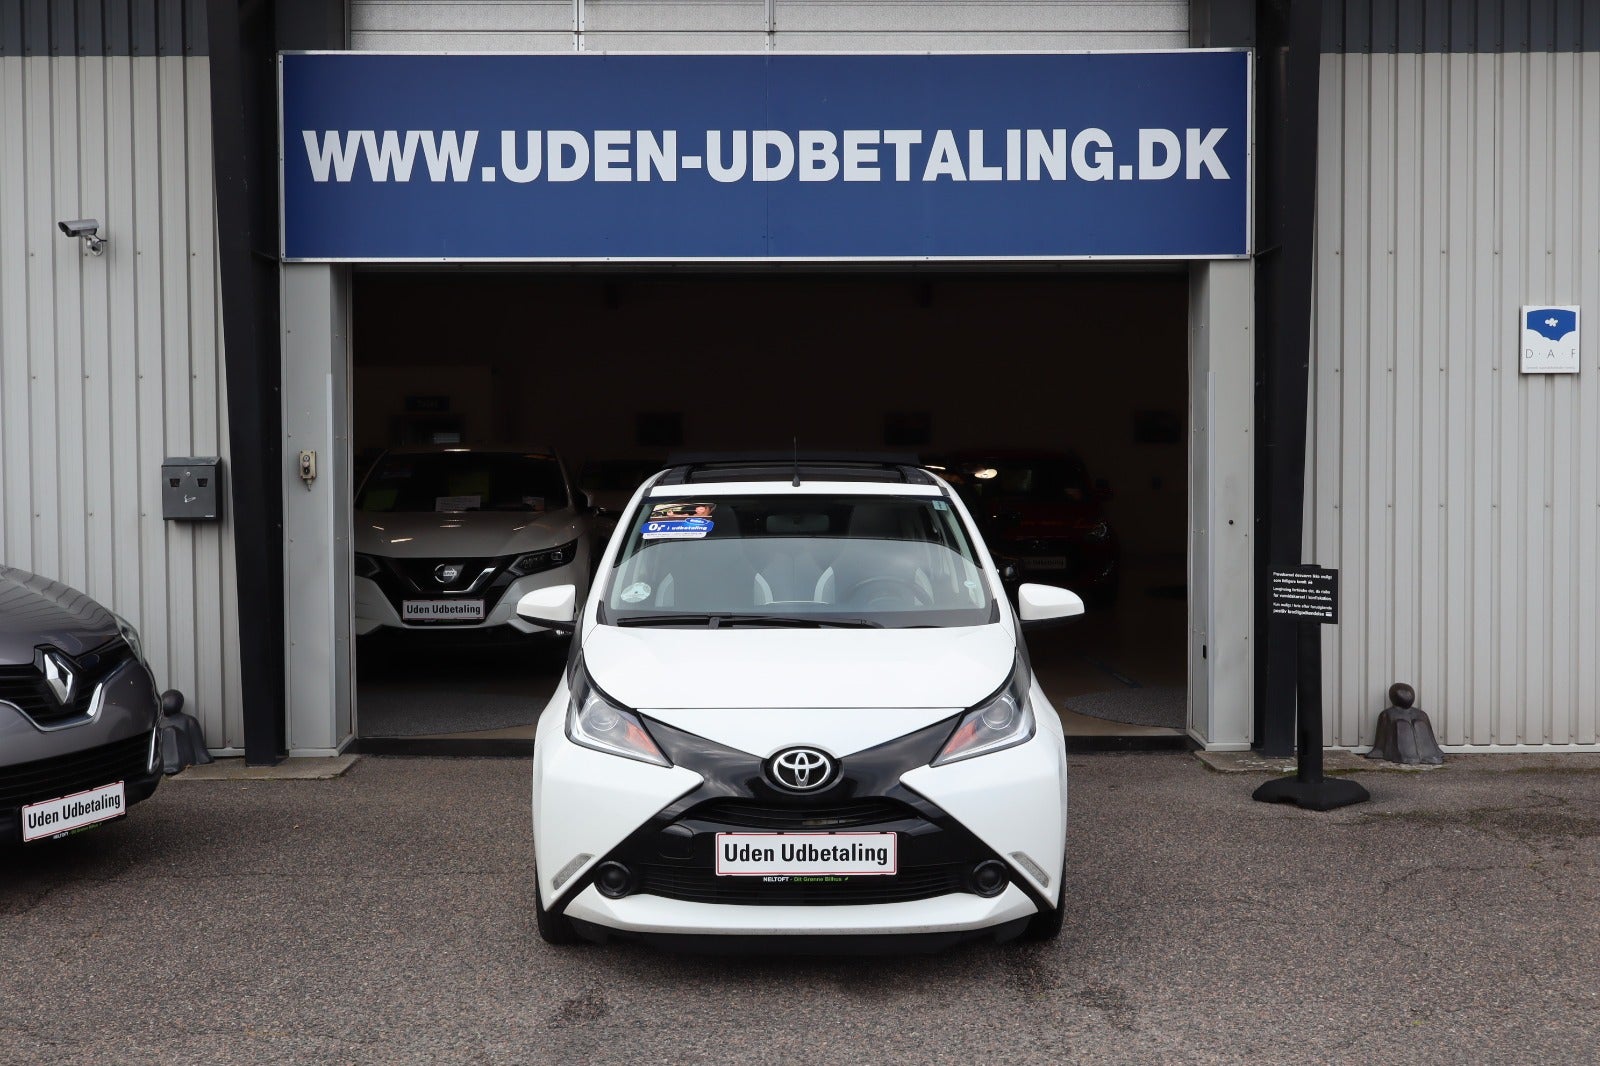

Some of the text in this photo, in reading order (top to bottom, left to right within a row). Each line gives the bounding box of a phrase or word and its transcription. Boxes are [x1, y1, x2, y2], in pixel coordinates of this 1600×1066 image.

[302, 127, 1231, 184] WWW.UDEN-UDBETALING.DK
[407, 604, 481, 616] Uden Udbetaling
[28, 810, 59, 829] Uden
[62, 793, 121, 820] Udbetaling
[724, 843, 888, 866] Uden Udbetaling
